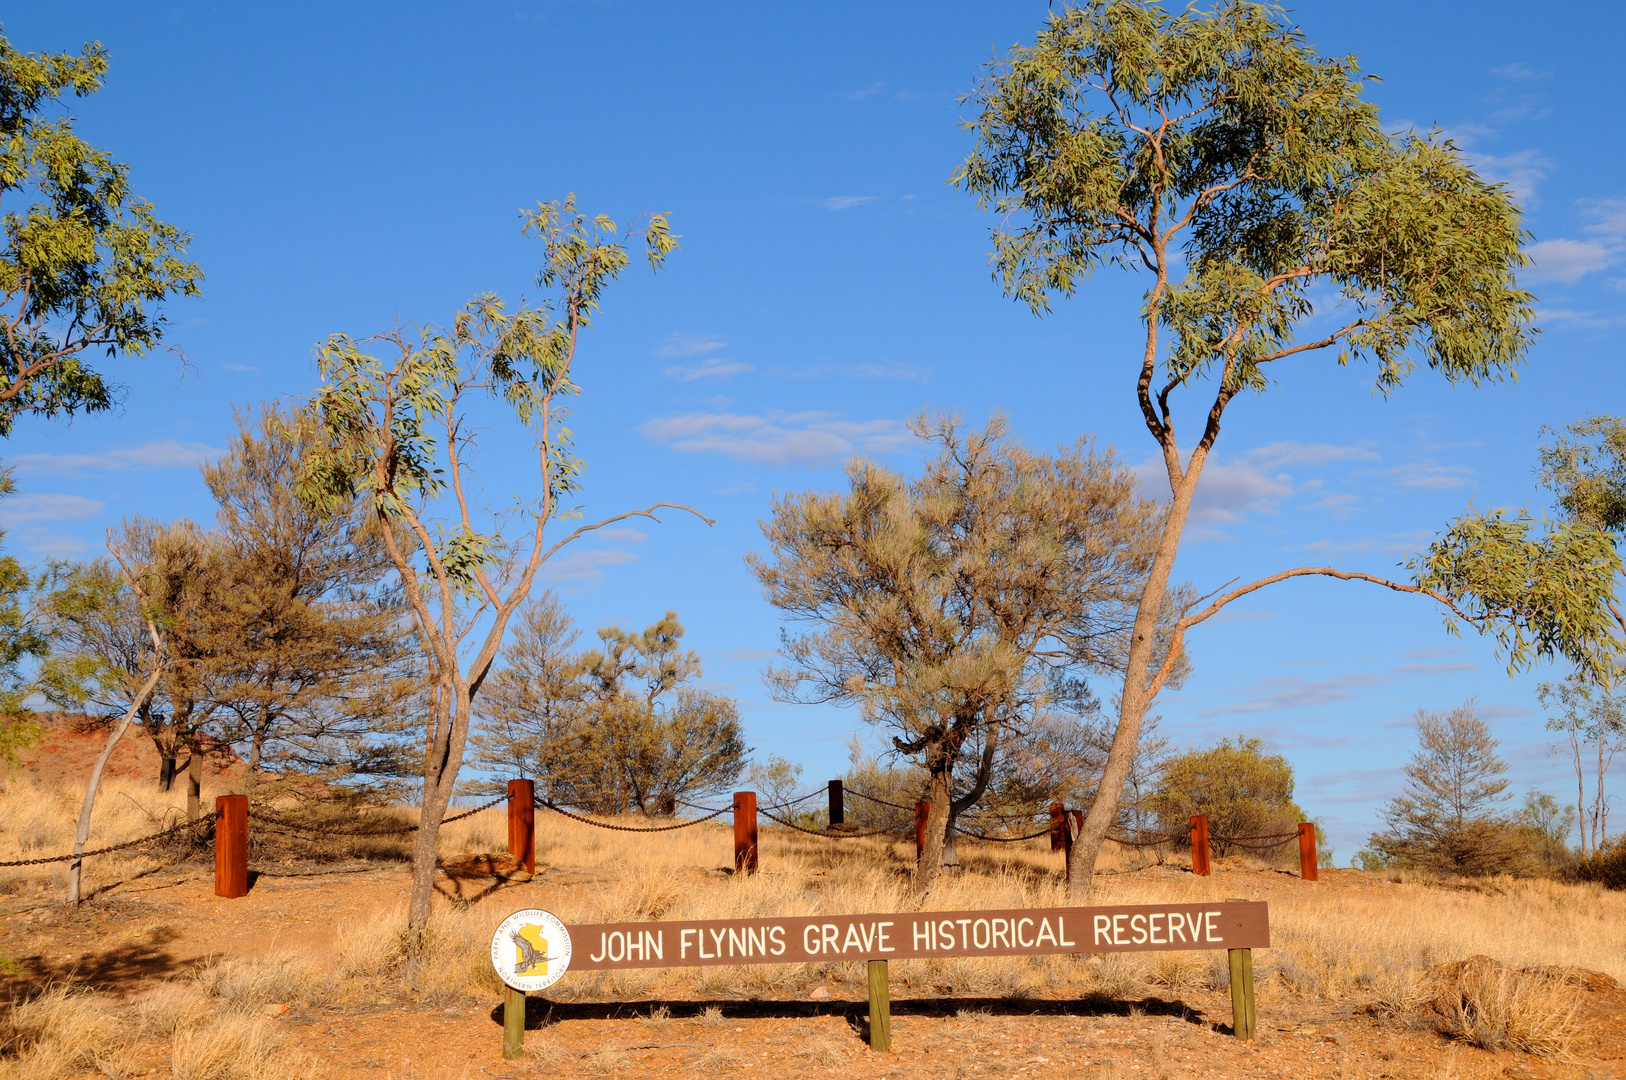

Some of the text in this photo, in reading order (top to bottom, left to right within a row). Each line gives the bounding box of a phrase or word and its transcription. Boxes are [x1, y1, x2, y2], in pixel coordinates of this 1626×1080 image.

[499, 920, 511, 935] AND
[512, 910, 544, 921] WILDLIFE
[546, 914, 571, 957] COMMISSION
[590, 911, 1224, 963] JOHN FLYNN'S GRAVE HISTORICAL RESERVE
[498, 964, 566, 990] NORTHERN TERRITORY
